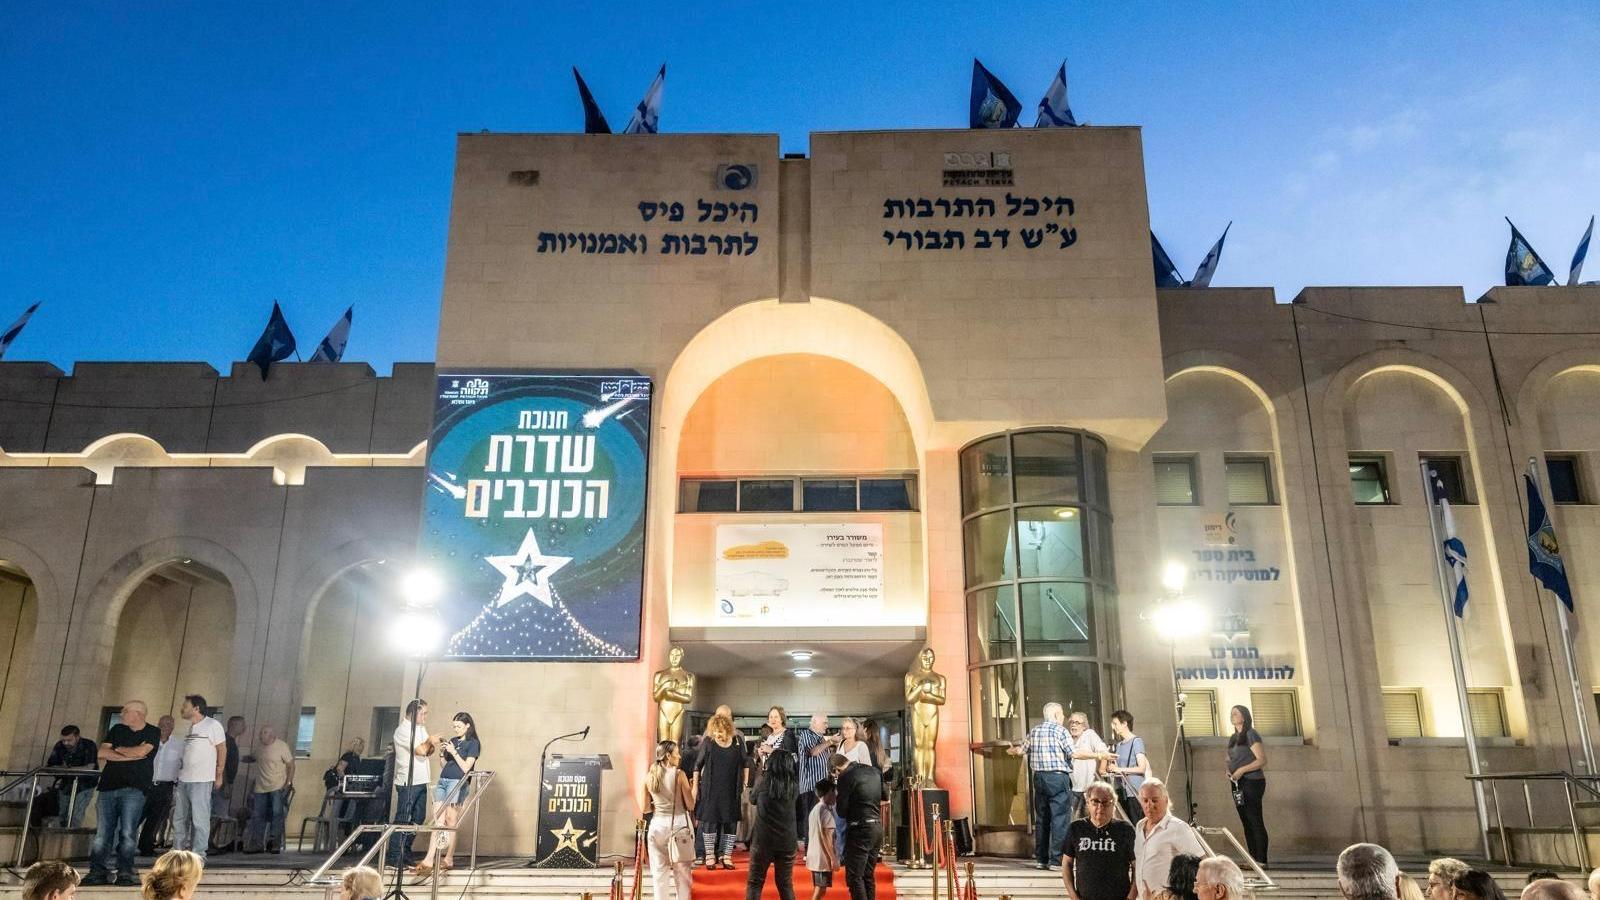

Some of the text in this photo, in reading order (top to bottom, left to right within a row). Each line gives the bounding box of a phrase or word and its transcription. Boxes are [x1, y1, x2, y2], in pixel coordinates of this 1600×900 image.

[638, 198, 759, 223] היכל פיס
[883, 192, 1075, 218] היכל התרבות
[537, 231, 759, 256] לתרבות ואמנויות
[883, 228, 966, 250] תבורי
[974, 228, 1011, 249] דב
[518, 410, 568, 429] חנוכת
[484, 435, 596, 473] שדרת
[464, 479, 610, 519] הכוכבים
[1192, 550, 1256, 562] בית ספר
[1216, 567, 1280, 583] למוסיקה
[1210, 646, 1259, 659] המרכז
[1175, 665, 1294, 680] להנצחת השואה
[554, 783, 588, 797] שדרת
[548, 798, 592, 812] הכוכבים
[1078, 837, 1117, 852] Drift
